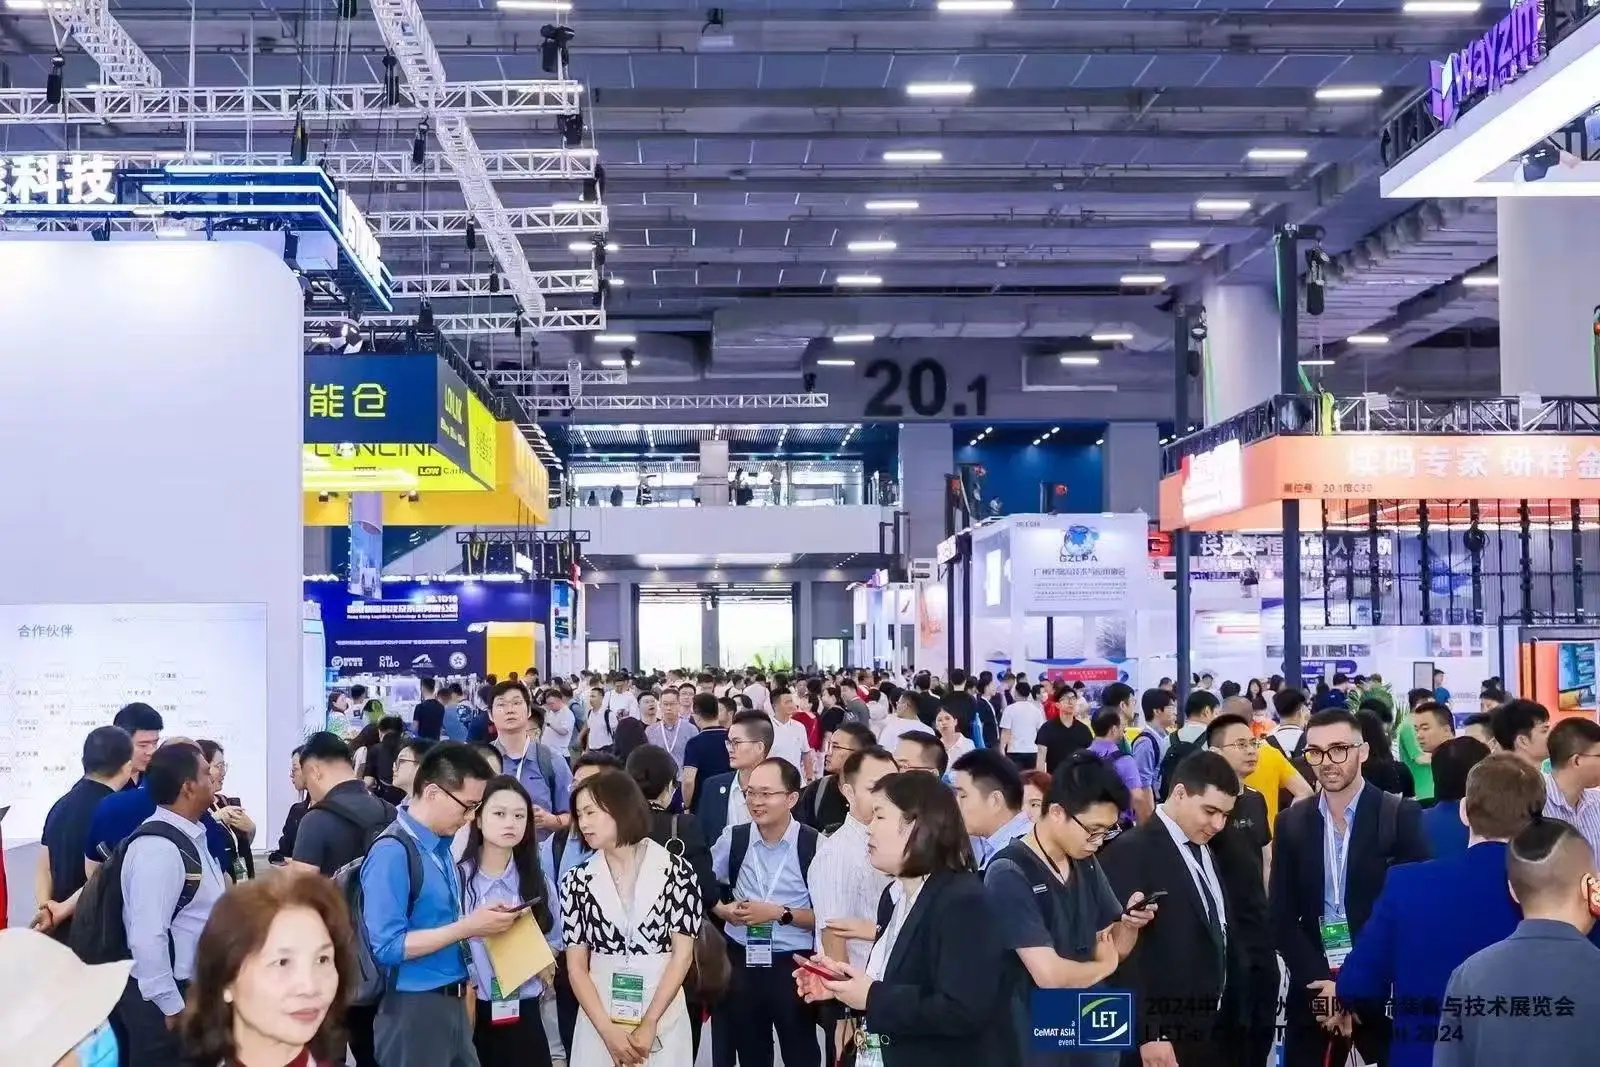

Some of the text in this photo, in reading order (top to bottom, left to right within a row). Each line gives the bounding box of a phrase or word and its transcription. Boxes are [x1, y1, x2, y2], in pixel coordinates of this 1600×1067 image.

[0, 154, 116, 203] 科技
[309, 383, 387, 418] 能仓
[863, 357, 987, 417] 20.1
[1060, 554, 1098, 563] GZLPA
[18, 624, 73, 638] 合作伙伴
